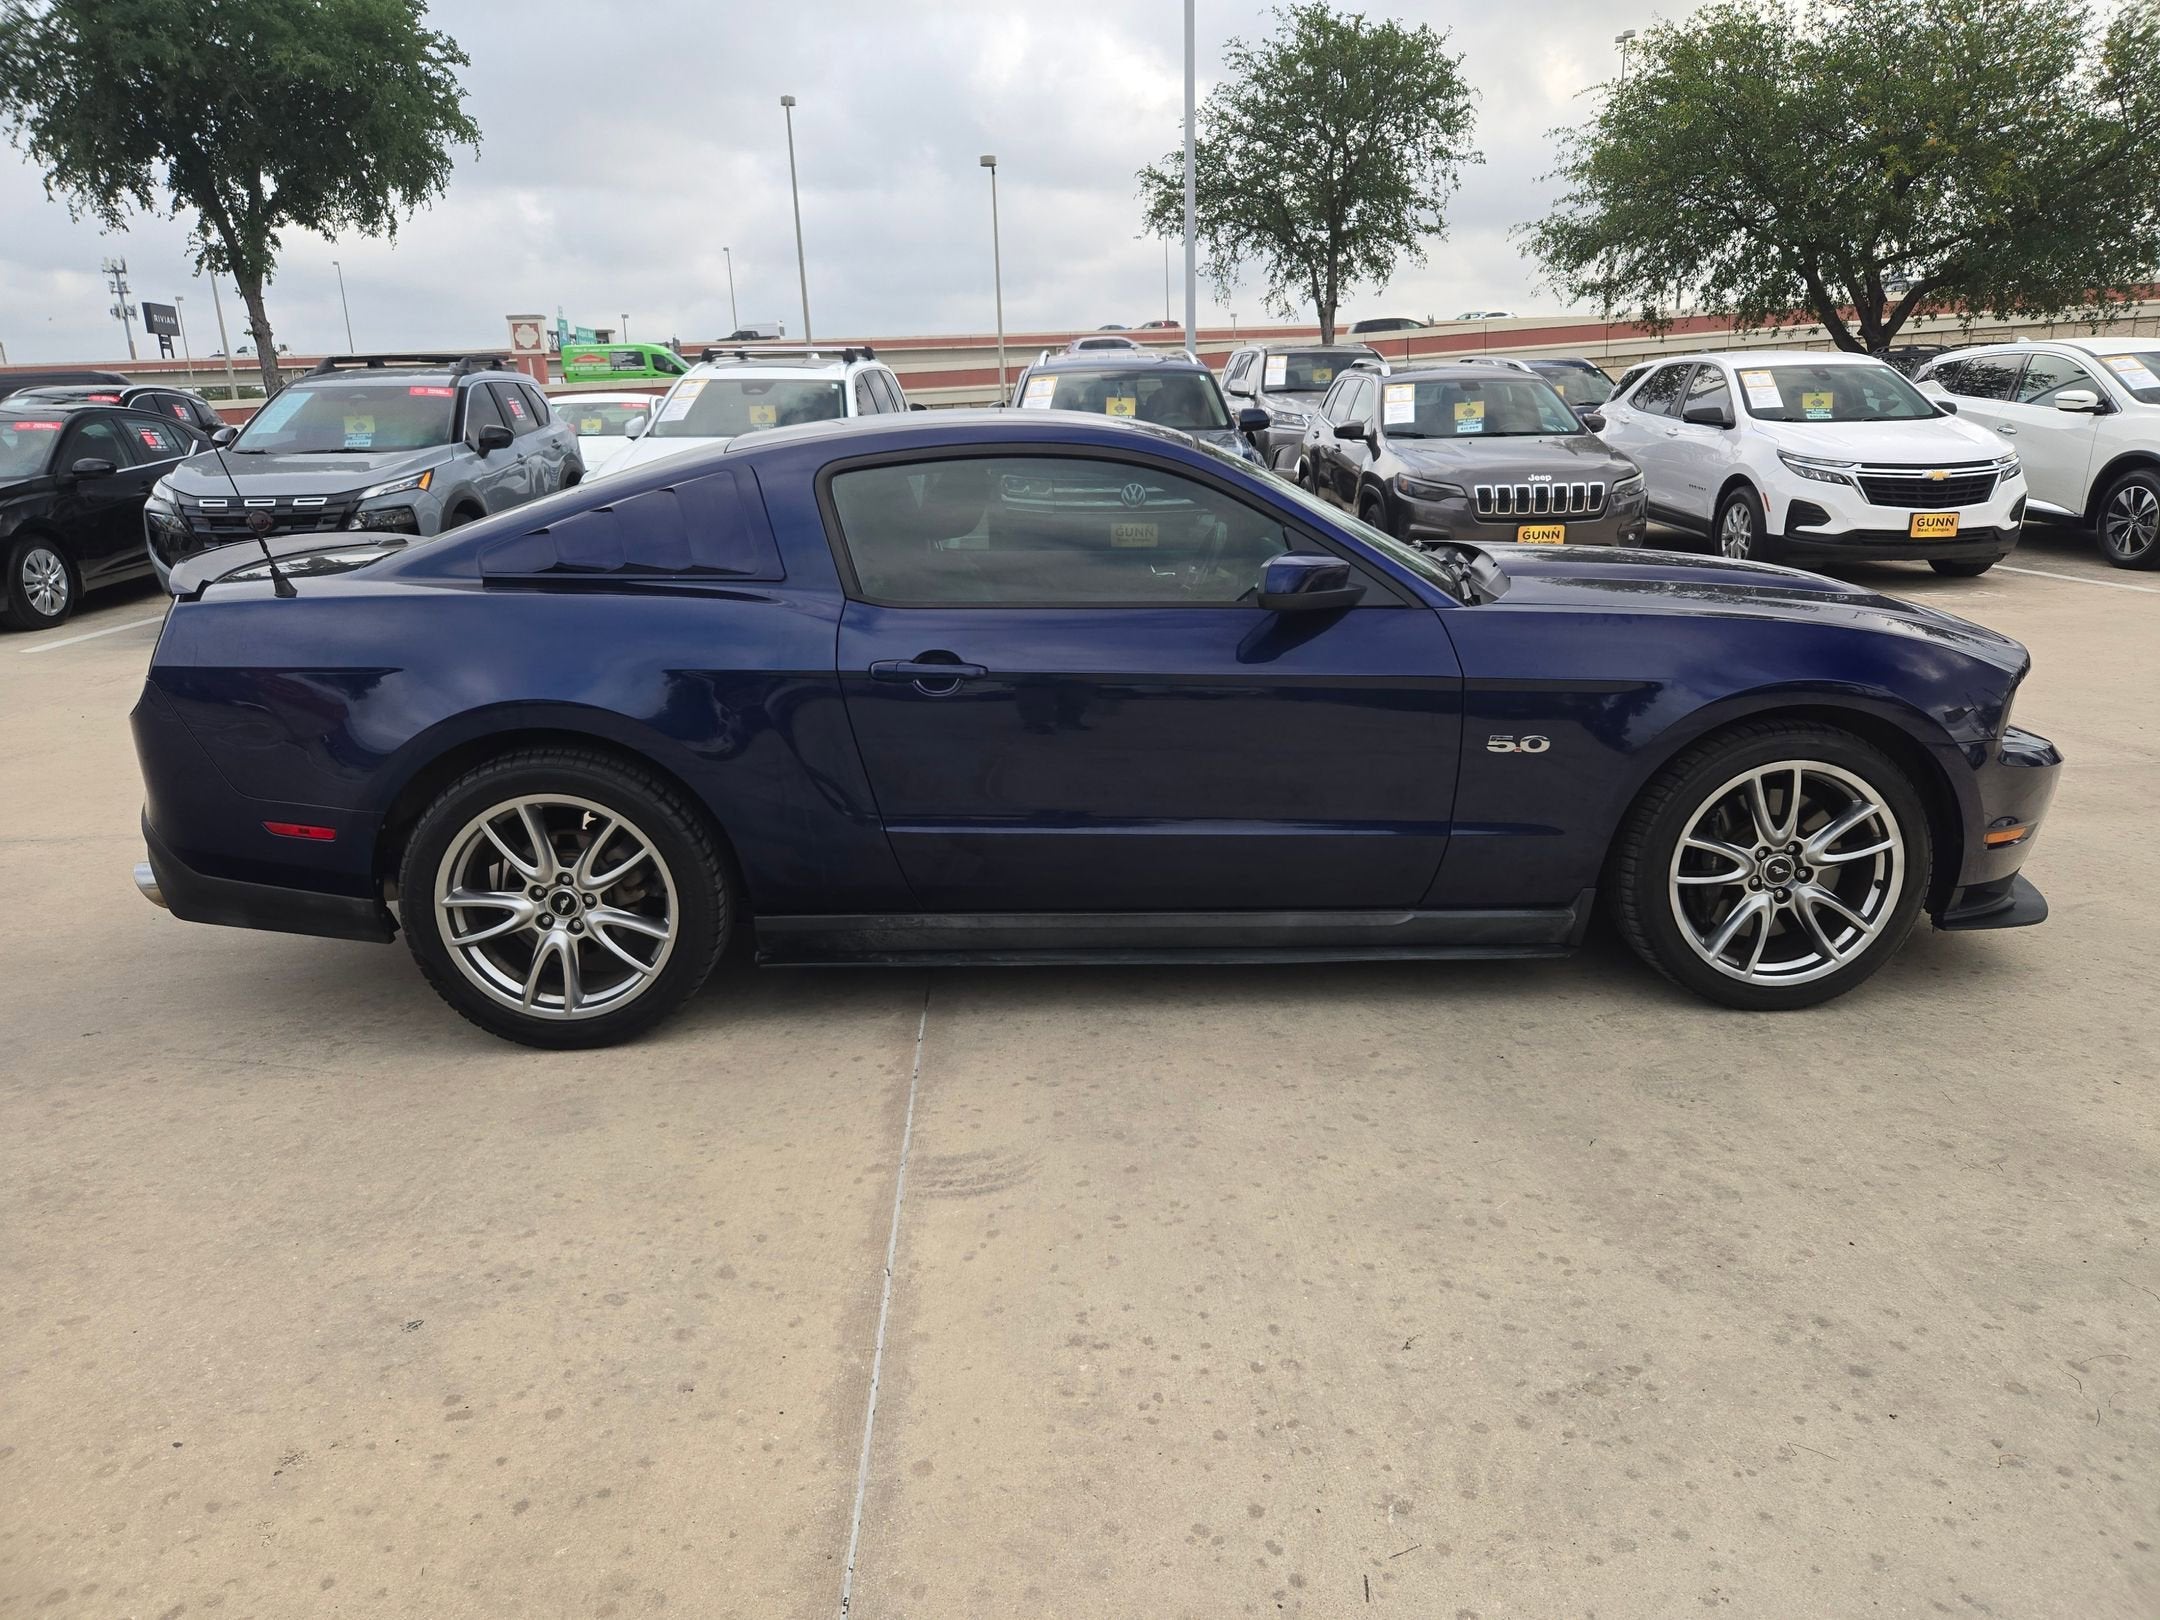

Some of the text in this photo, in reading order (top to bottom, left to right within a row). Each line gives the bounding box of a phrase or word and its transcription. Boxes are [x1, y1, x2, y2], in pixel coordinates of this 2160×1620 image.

[153, 313, 176, 325] RIVIAN
[1527, 474, 1552, 482] Jeep
[1916, 517, 1955, 527] GUNN
[1115, 527, 1154, 537] GUNN
[1522, 530, 1560, 540] GUNN
[1486, 734, 1551, 753] 5.0
